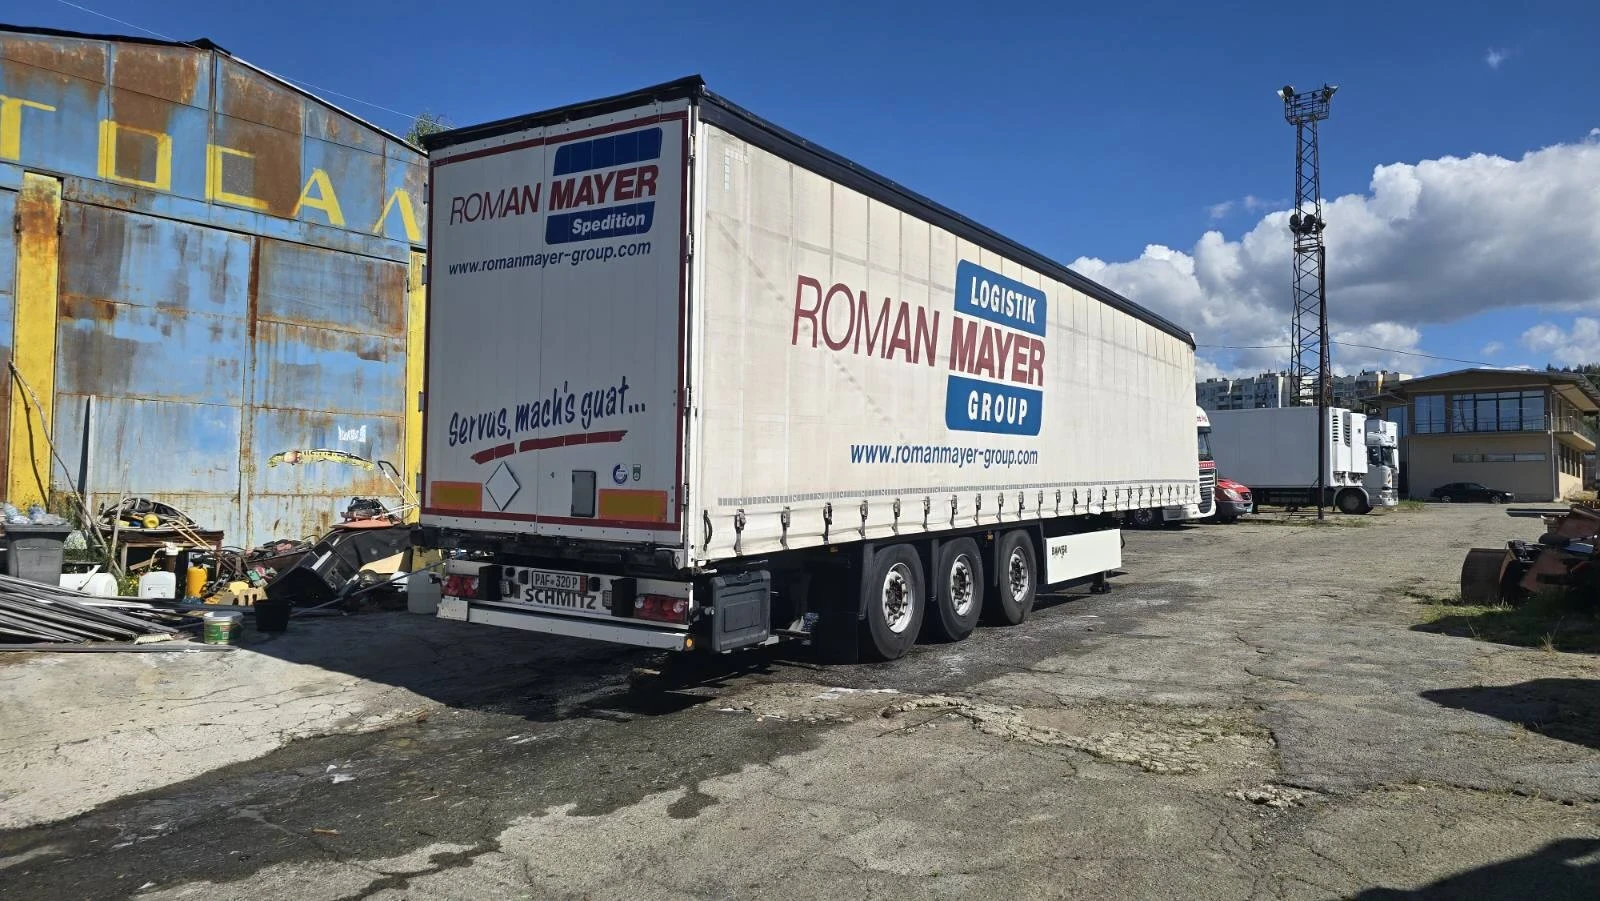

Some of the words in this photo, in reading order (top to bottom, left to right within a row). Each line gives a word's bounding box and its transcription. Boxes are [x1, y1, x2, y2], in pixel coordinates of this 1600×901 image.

[450, 182, 541, 225] ROMAN
[549, 165, 658, 211] MAYER
[572, 213, 645, 235] Spedition
[449, 241, 651, 275] www.romanmayer-group.com
[971, 276, 1036, 324] LOGISTIK
[791, 274, 940, 367] ROMAN
[949, 316, 1045, 386] MAYER
[449, 407, 511, 446] Servus,
[515, 380, 575, 432] mach's
[580, 376, 645, 429] guat...
[968, 390, 1027, 425] GROUP
[850, 444, 1038, 468] www.romanmayer-group.com
[525, 588, 597, 610] SCHMITZ
